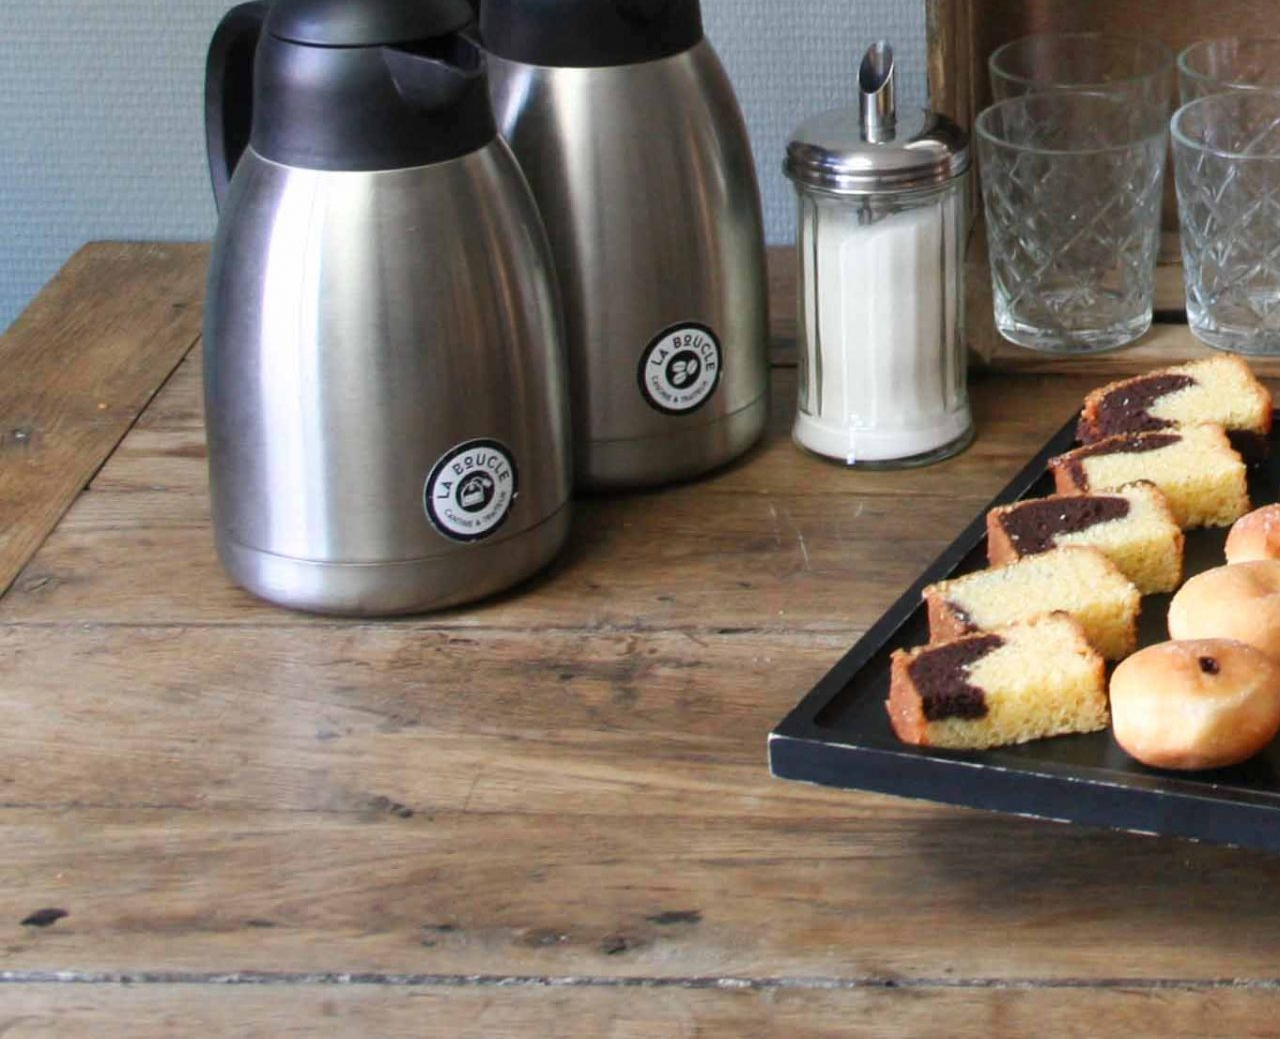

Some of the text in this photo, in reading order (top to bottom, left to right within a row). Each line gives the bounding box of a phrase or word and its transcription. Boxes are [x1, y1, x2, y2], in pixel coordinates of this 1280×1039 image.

[651, 334, 715, 372] LA BOUCLE
[436, 453, 510, 499] LA BOUCLE
